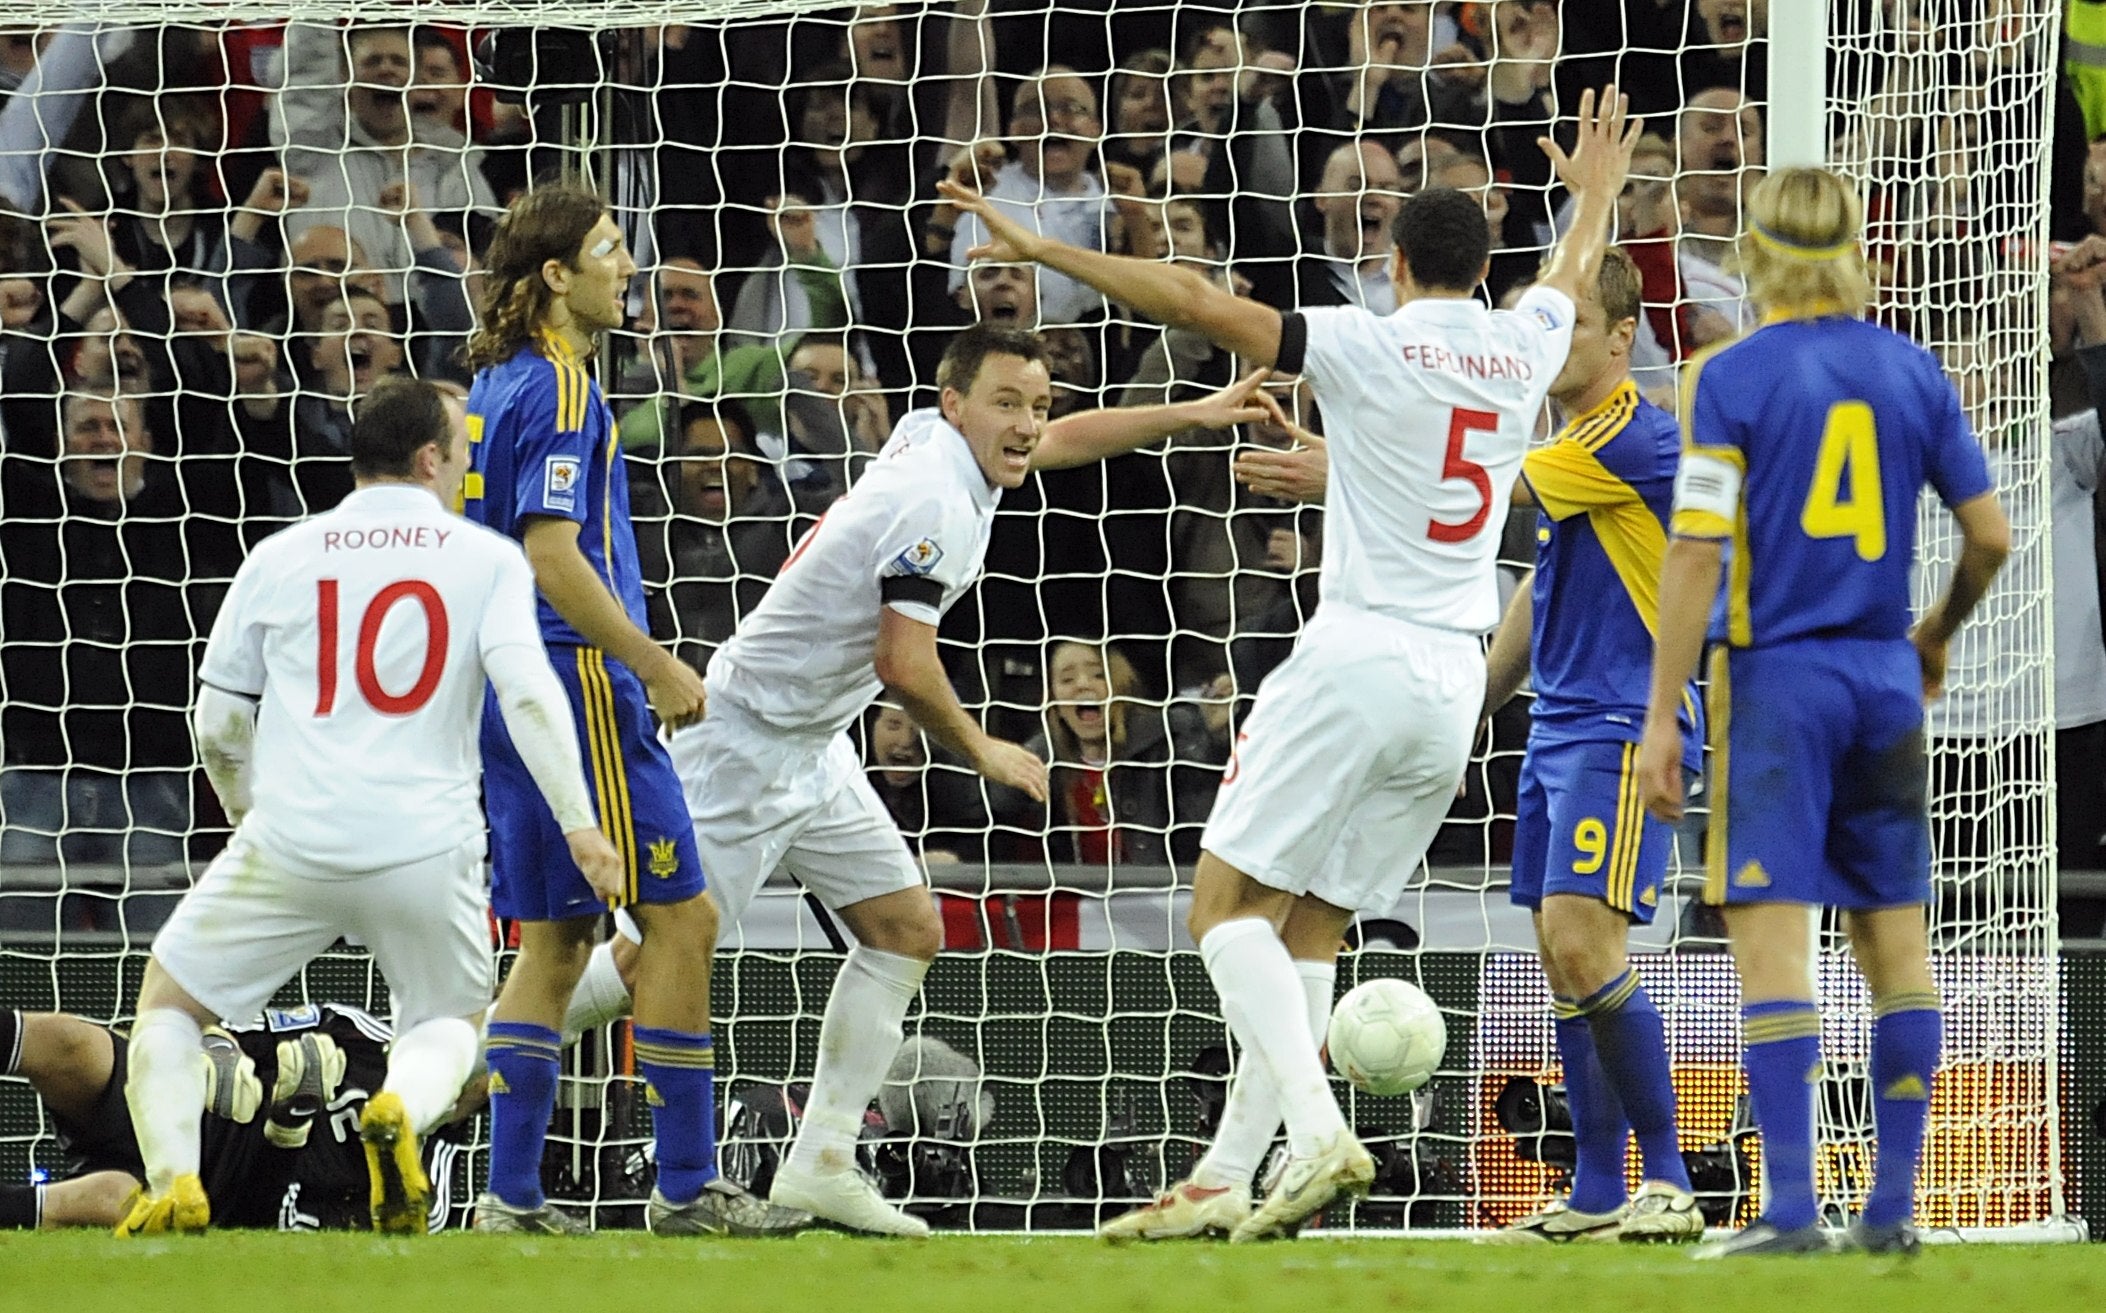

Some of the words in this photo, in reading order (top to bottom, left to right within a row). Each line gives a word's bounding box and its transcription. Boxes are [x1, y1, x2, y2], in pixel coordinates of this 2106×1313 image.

[325, 527, 451, 552] ROONEY
[1426, 406, 1499, 544] 5
[1801, 400, 1887, 562] 4
[313, 577, 449, 718] 10
[1572, 817, 1607, 874] 9
